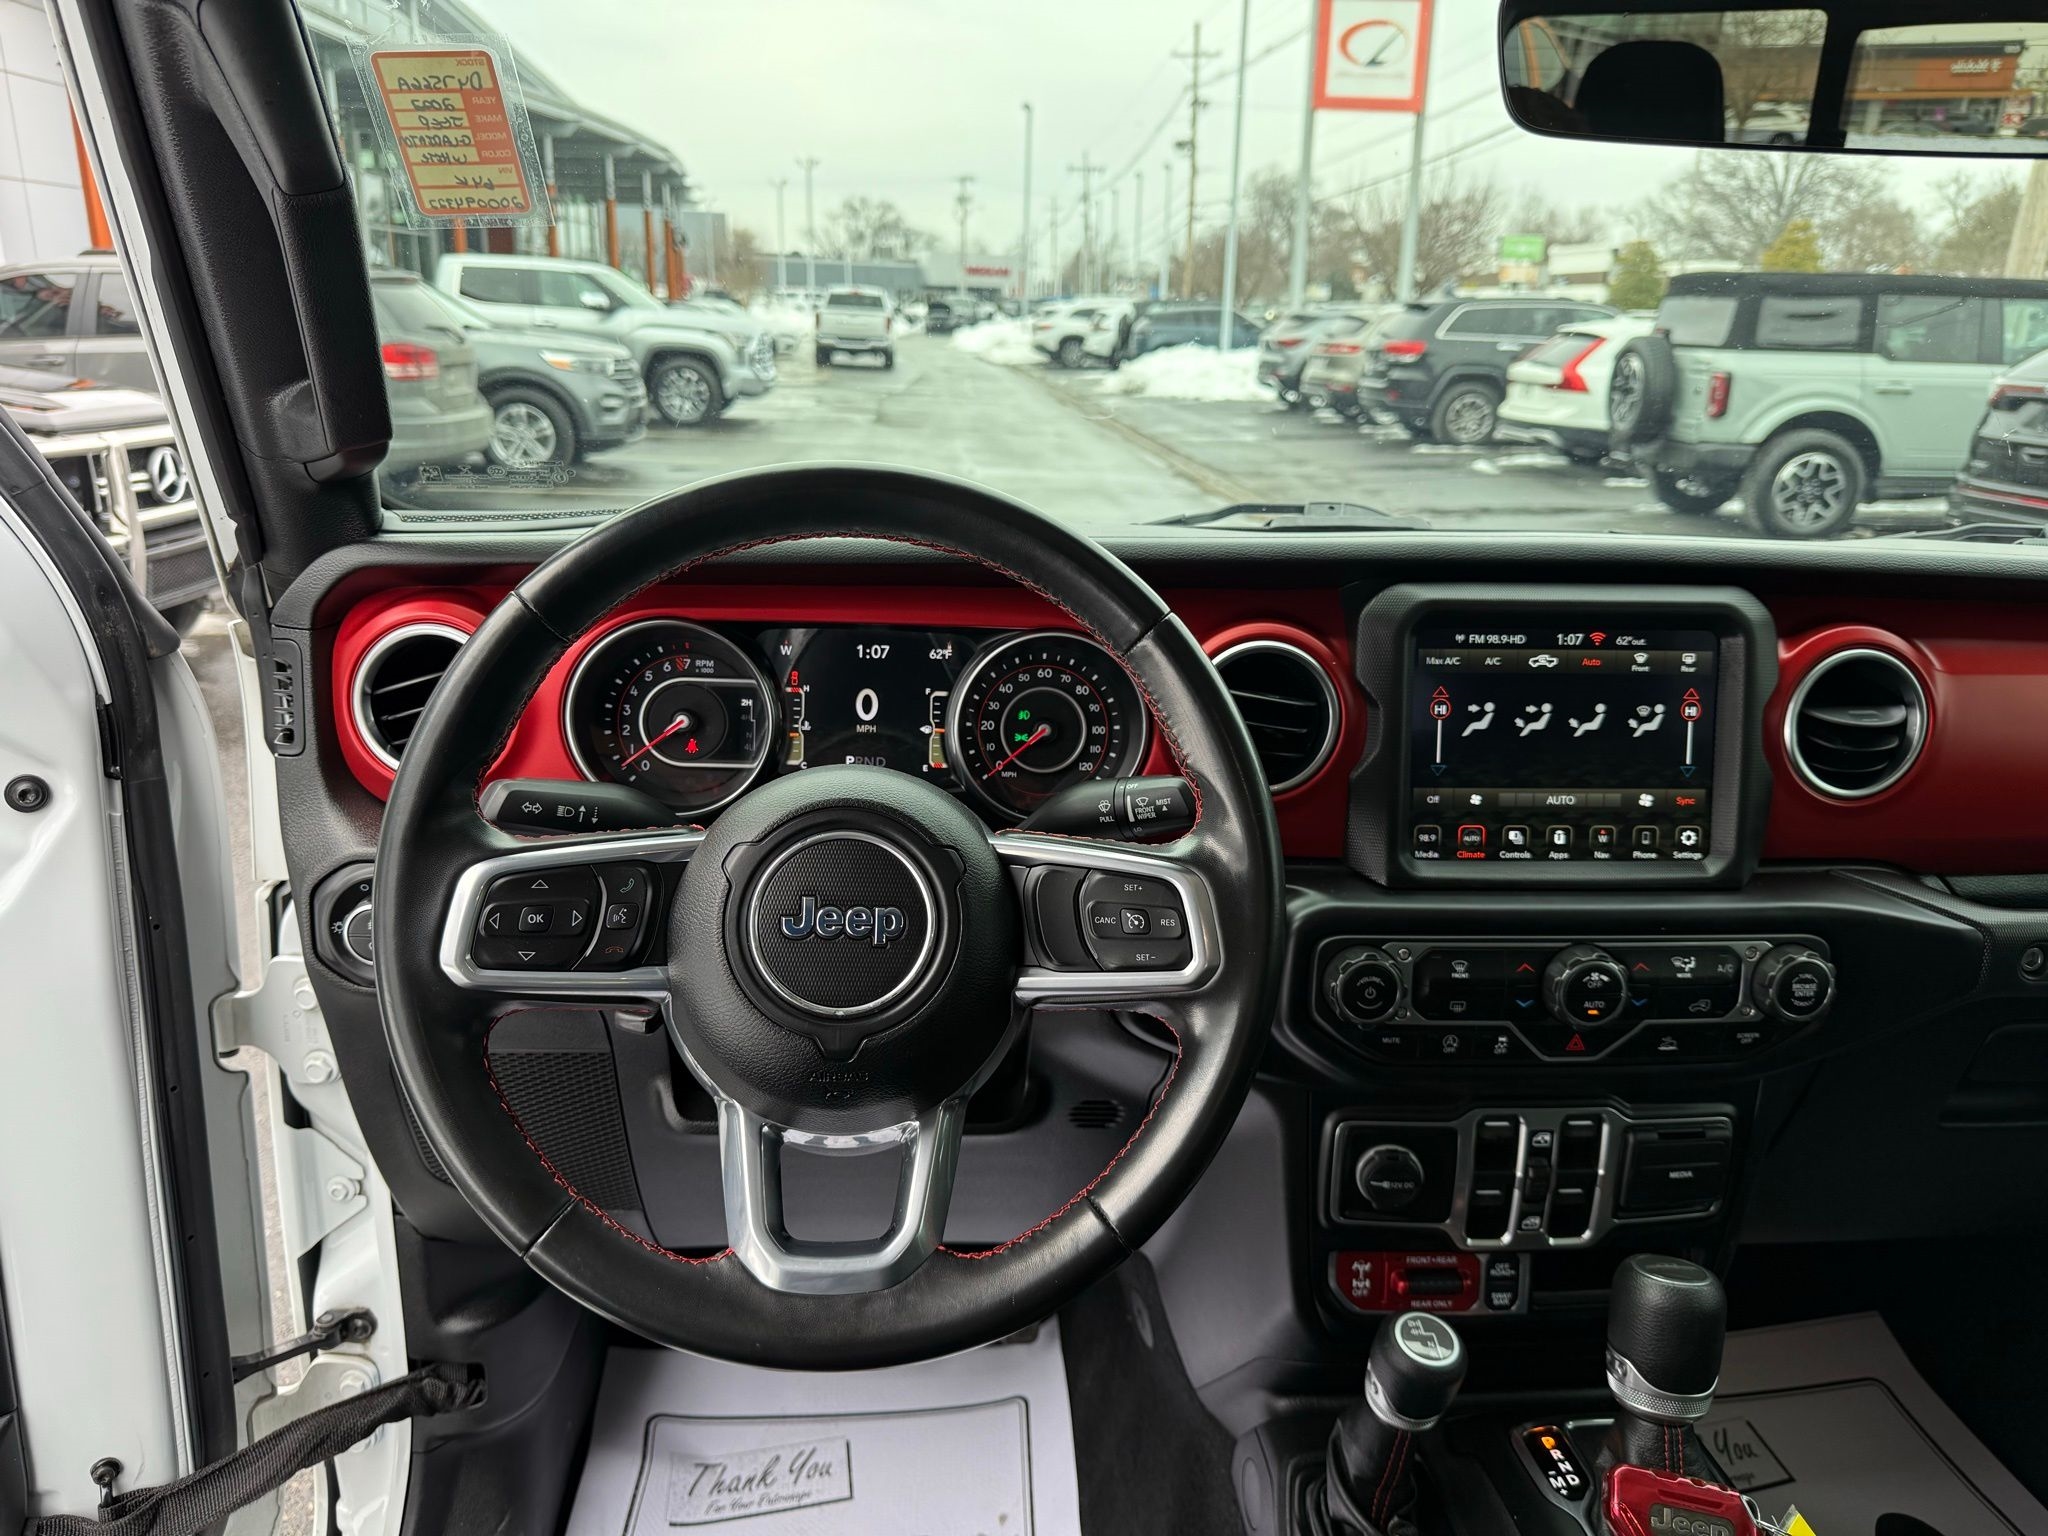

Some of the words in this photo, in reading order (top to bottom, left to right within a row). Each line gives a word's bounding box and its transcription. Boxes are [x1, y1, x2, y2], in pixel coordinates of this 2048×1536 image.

[1468, 634, 1485, 645] FM
[1486, 634, 1527, 645] 98.9-HD
[1556, 633, 1584, 646] 1:07
[780, 645, 793, 656] W
[855, 644, 890, 659] 1:07
[929, 648, 952, 660] 62°F
[683, 658, 691, 670] 7
[695, 659, 715, 668] RPM
[1425, 656, 1443, 666] Max
[1444, 656, 1462, 666] A/C
[1484, 656, 1502, 666] A/C
[1581, 657, 1603, 667] Auto
[663, 661, 672, 673] 6
[1631, 664, 1650, 673] Front
[644, 670, 653, 682] 5
[1018, 673, 1030, 683] 50
[1037, 668, 1053, 679] 60
[1060, 674, 1072, 684] 70
[630, 685, 639, 697] 4
[999, 683, 1014, 694] 40
[1075, 685, 1090, 696] 80
[855, 687, 879, 722] 0
[988, 701, 1000, 711] 30
[1088, 703, 1101, 713] 90
[622, 704, 632, 716] 3
[622, 725, 631, 736] 2
[856, 724, 877, 733] MPH
[980, 720, 995, 731] 20
[1091, 725, 1106, 735] 100
[986, 742, 996, 752] 10
[1089, 745, 1102, 754] 110
[641, 759, 651, 772] 0
[1079, 761, 1093, 771] 120
[1001, 770, 1018, 779] MPH
[1155, 797, 1171, 806] MIST
[1546, 794, 1576, 806] AUTO
[1675, 796, 1696, 806] Sync
[1134, 805, 1155, 815] FRONT
[1099, 815, 1115, 823] PULL
[1136, 811, 1157, 820] WIPER
[1418, 833, 1436, 843] 98.9
[1414, 850, 1439, 860] Media
[1456, 850, 1486, 860] Climate
[1499, 850, 1533, 860] Controls
[1549, 850, 1569, 861] Apps
[1593, 850, 1610, 860] Nav
[1632, 850, 1657, 860] Phone
[1672, 850, 1703, 861] Settings
[527, 913, 544, 924] OK
[780, 896, 904, 945] Jeep
[1094, 916, 1117, 925] CANC
[1160, 918, 1176, 927] RES
[1716, 964, 1734, 973] A/C
[1587, 980, 1603, 989] OFF
[1584, 1000, 1605, 1009] AUTO
[1382, 1036, 1400, 1044] MUTE
[1668, 1170, 1694, 1179] MEDIA
[1410, 1300, 1432, 1309] REAR
[1433, 1300, 1454, 1309] ONLY
[1713, 1427, 1759, 1465] You
[1549, 1448, 1566, 1461] R
[688, 1453, 781, 1498] Thank
[788, 1446, 832, 1487] You
[1557, 1461, 1574, 1473] N
[1565, 1474, 1580, 1486] D
[1650, 1507, 1730, 1536] Jeep
